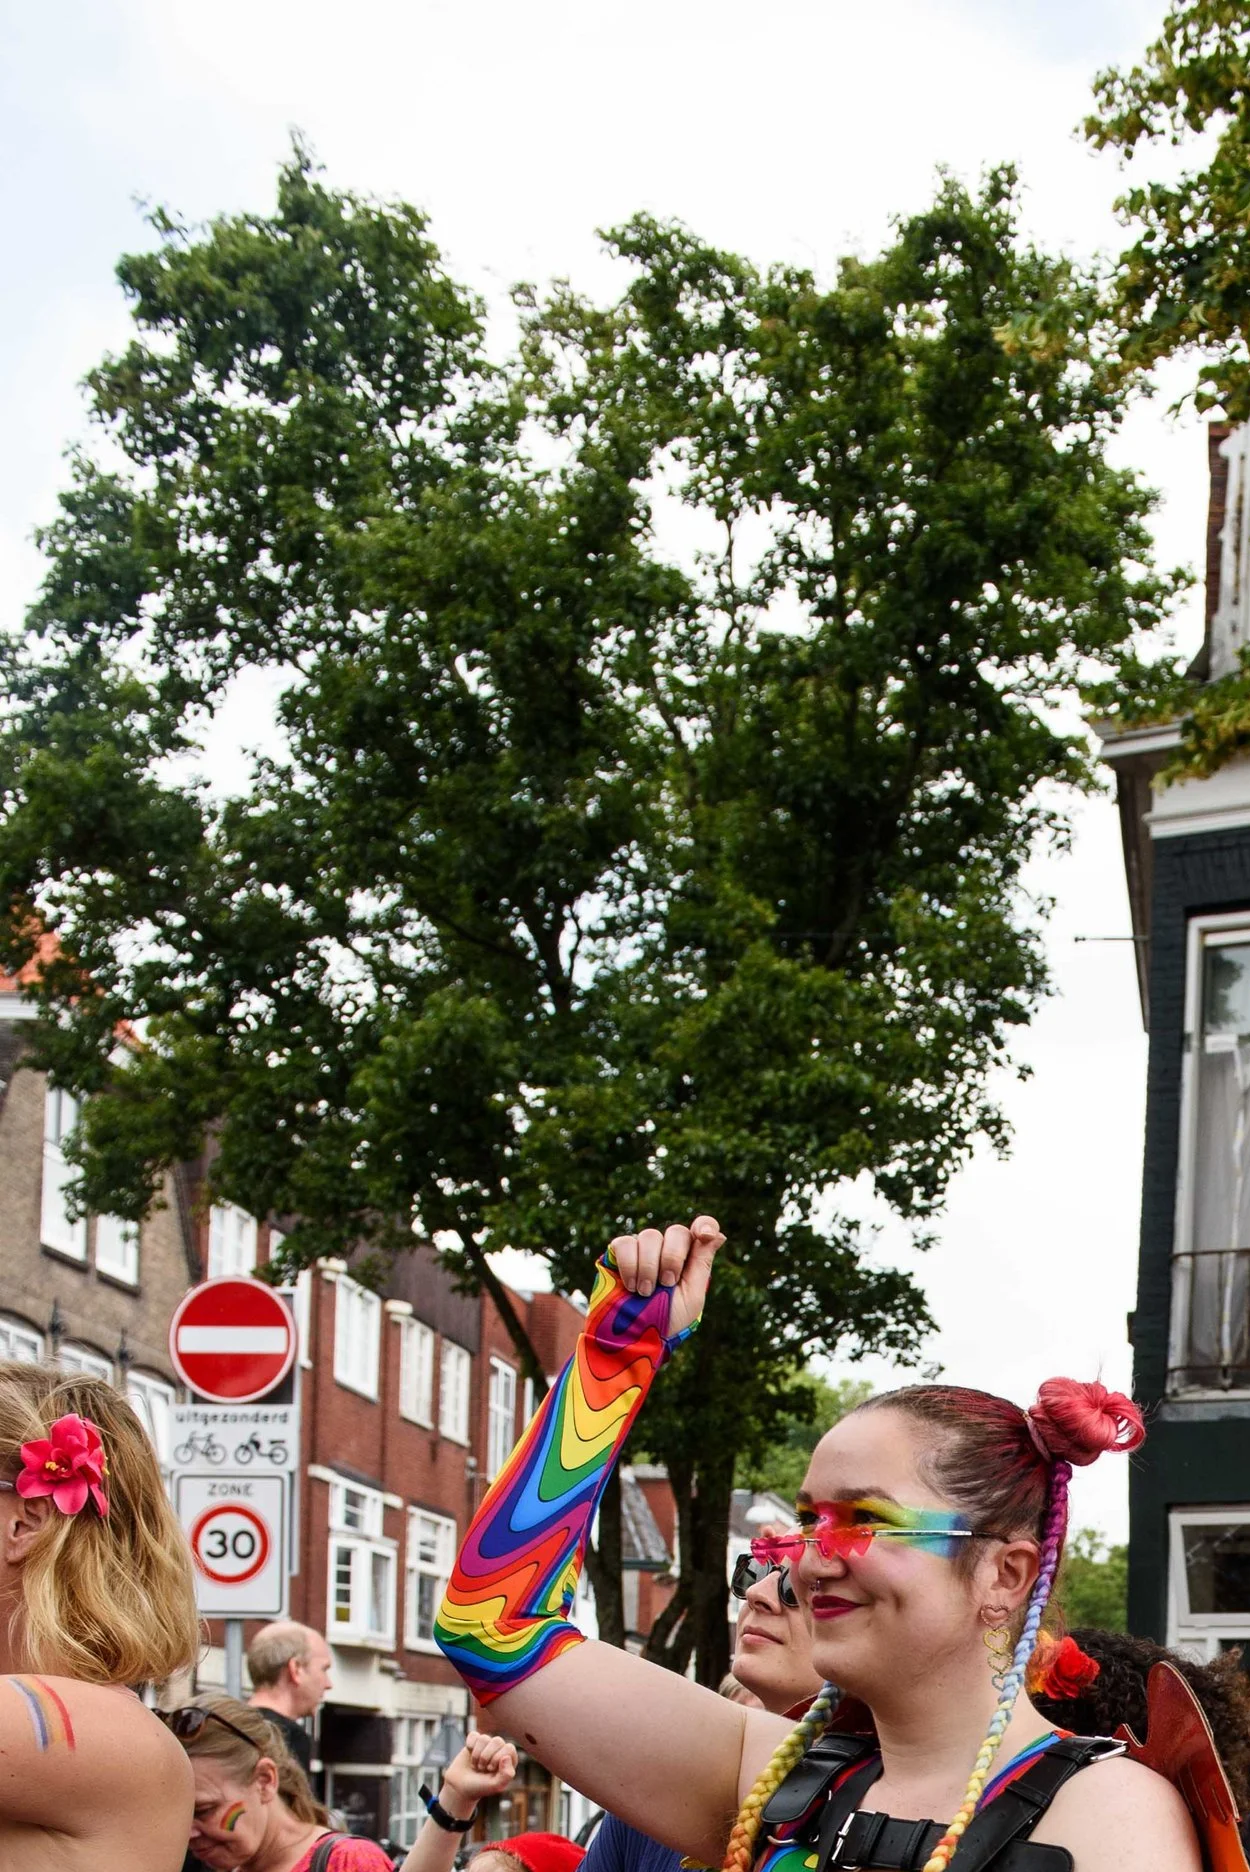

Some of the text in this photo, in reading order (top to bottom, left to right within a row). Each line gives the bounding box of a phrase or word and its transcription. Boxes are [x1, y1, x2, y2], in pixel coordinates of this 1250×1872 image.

[175, 1412, 289, 1425] uitgezonderd
[208, 1484, 254, 1496] ZONE
[206, 1530, 255, 1559] 30
